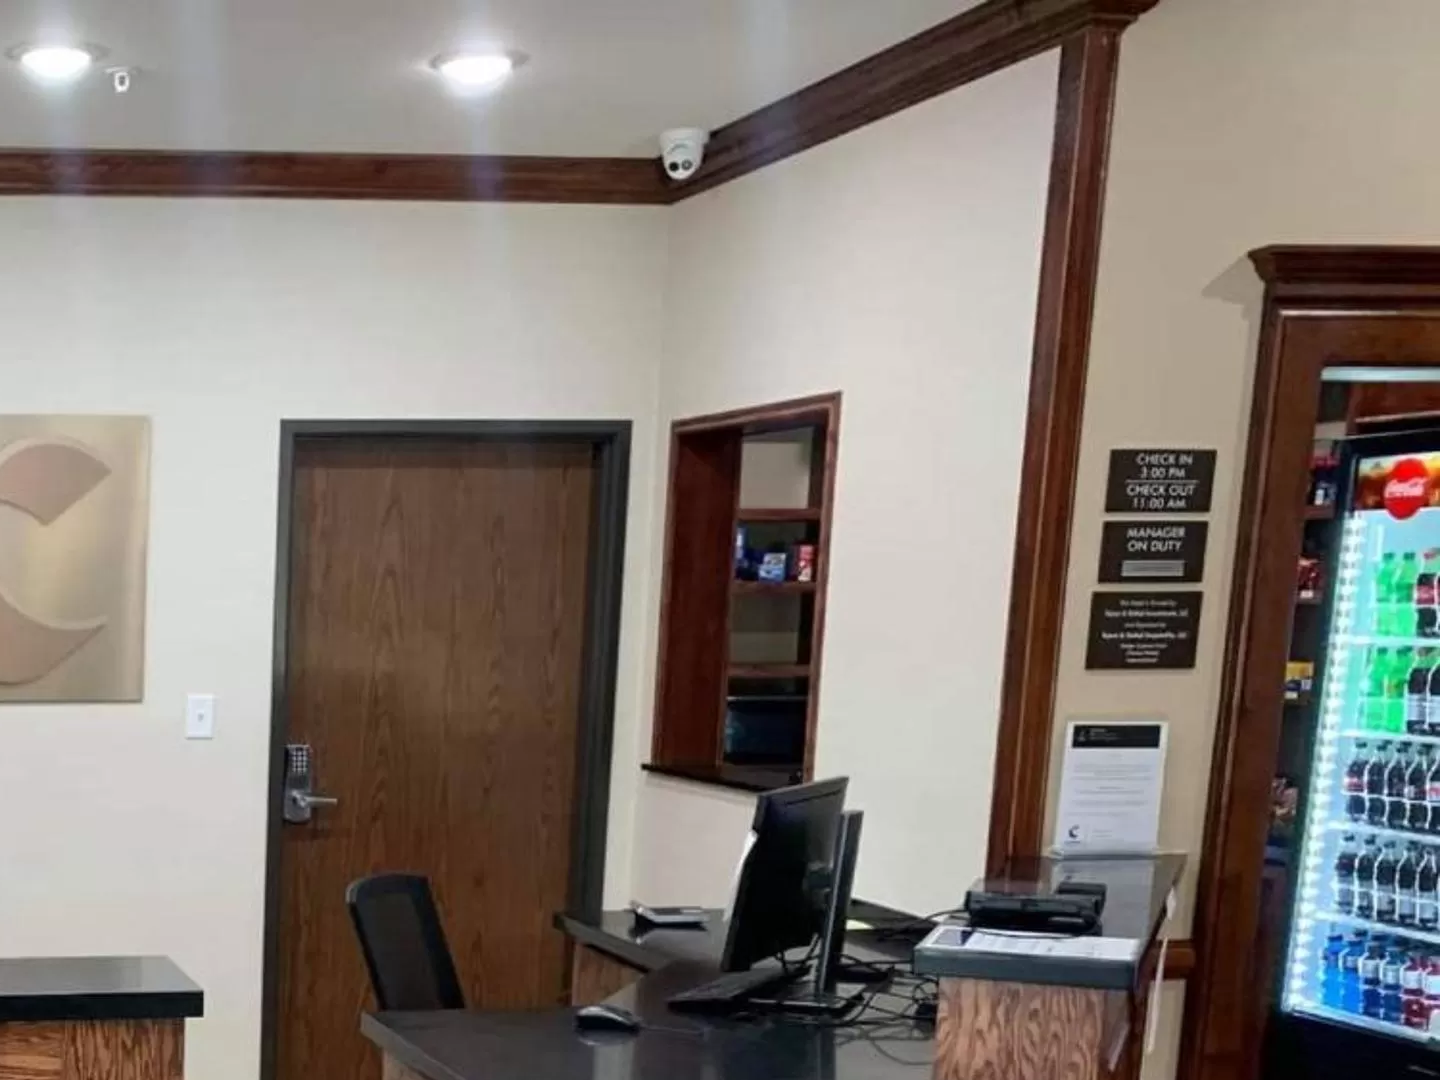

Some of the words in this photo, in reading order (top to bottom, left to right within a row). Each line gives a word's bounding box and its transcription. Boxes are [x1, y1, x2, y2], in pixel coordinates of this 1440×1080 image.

[1136, 453, 1176, 466] CHECK
[1178, 453, 1194, 466] IN
[1168, 466, 1186, 478] PM
[1126, 484, 1166, 496] CHECK
[1168, 484, 1195, 496] OUT
[1167, 498, 1187, 509] AM
[1126, 526, 1186, 539] MANAGER
[1127, 540, 1148, 552] ON
[1150, 540, 1182, 552] DUTY
